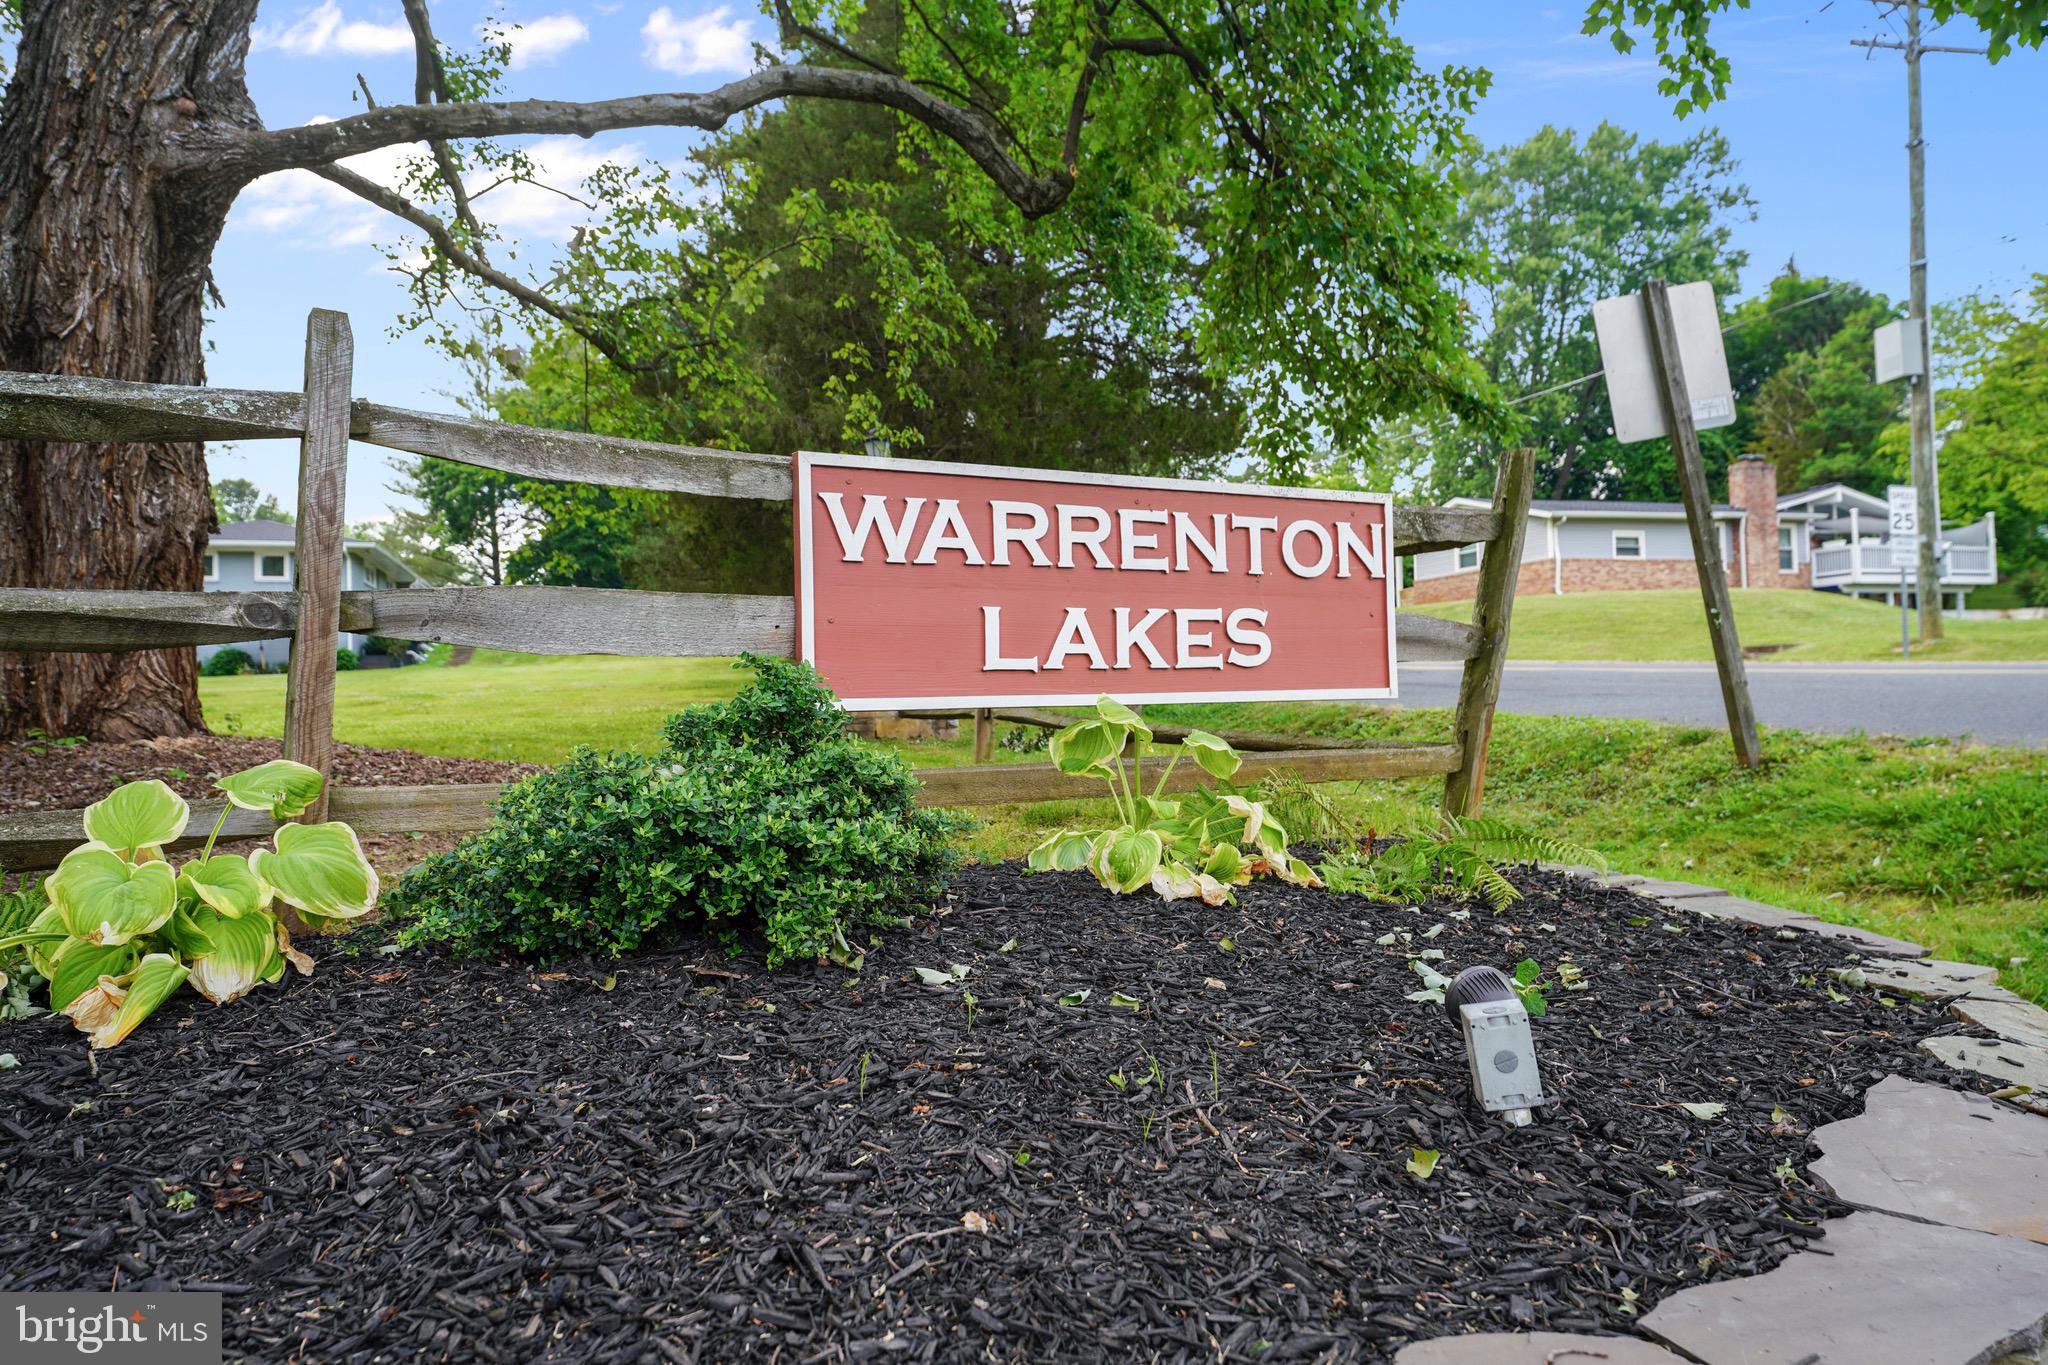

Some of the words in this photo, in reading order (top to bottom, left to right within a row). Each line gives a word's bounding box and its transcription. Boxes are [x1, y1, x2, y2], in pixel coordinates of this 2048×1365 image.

[818, 492, 1385, 579] WARRENTON
[1893, 513, 1914, 530] 25
[981, 605, 1273, 673] LAKES
